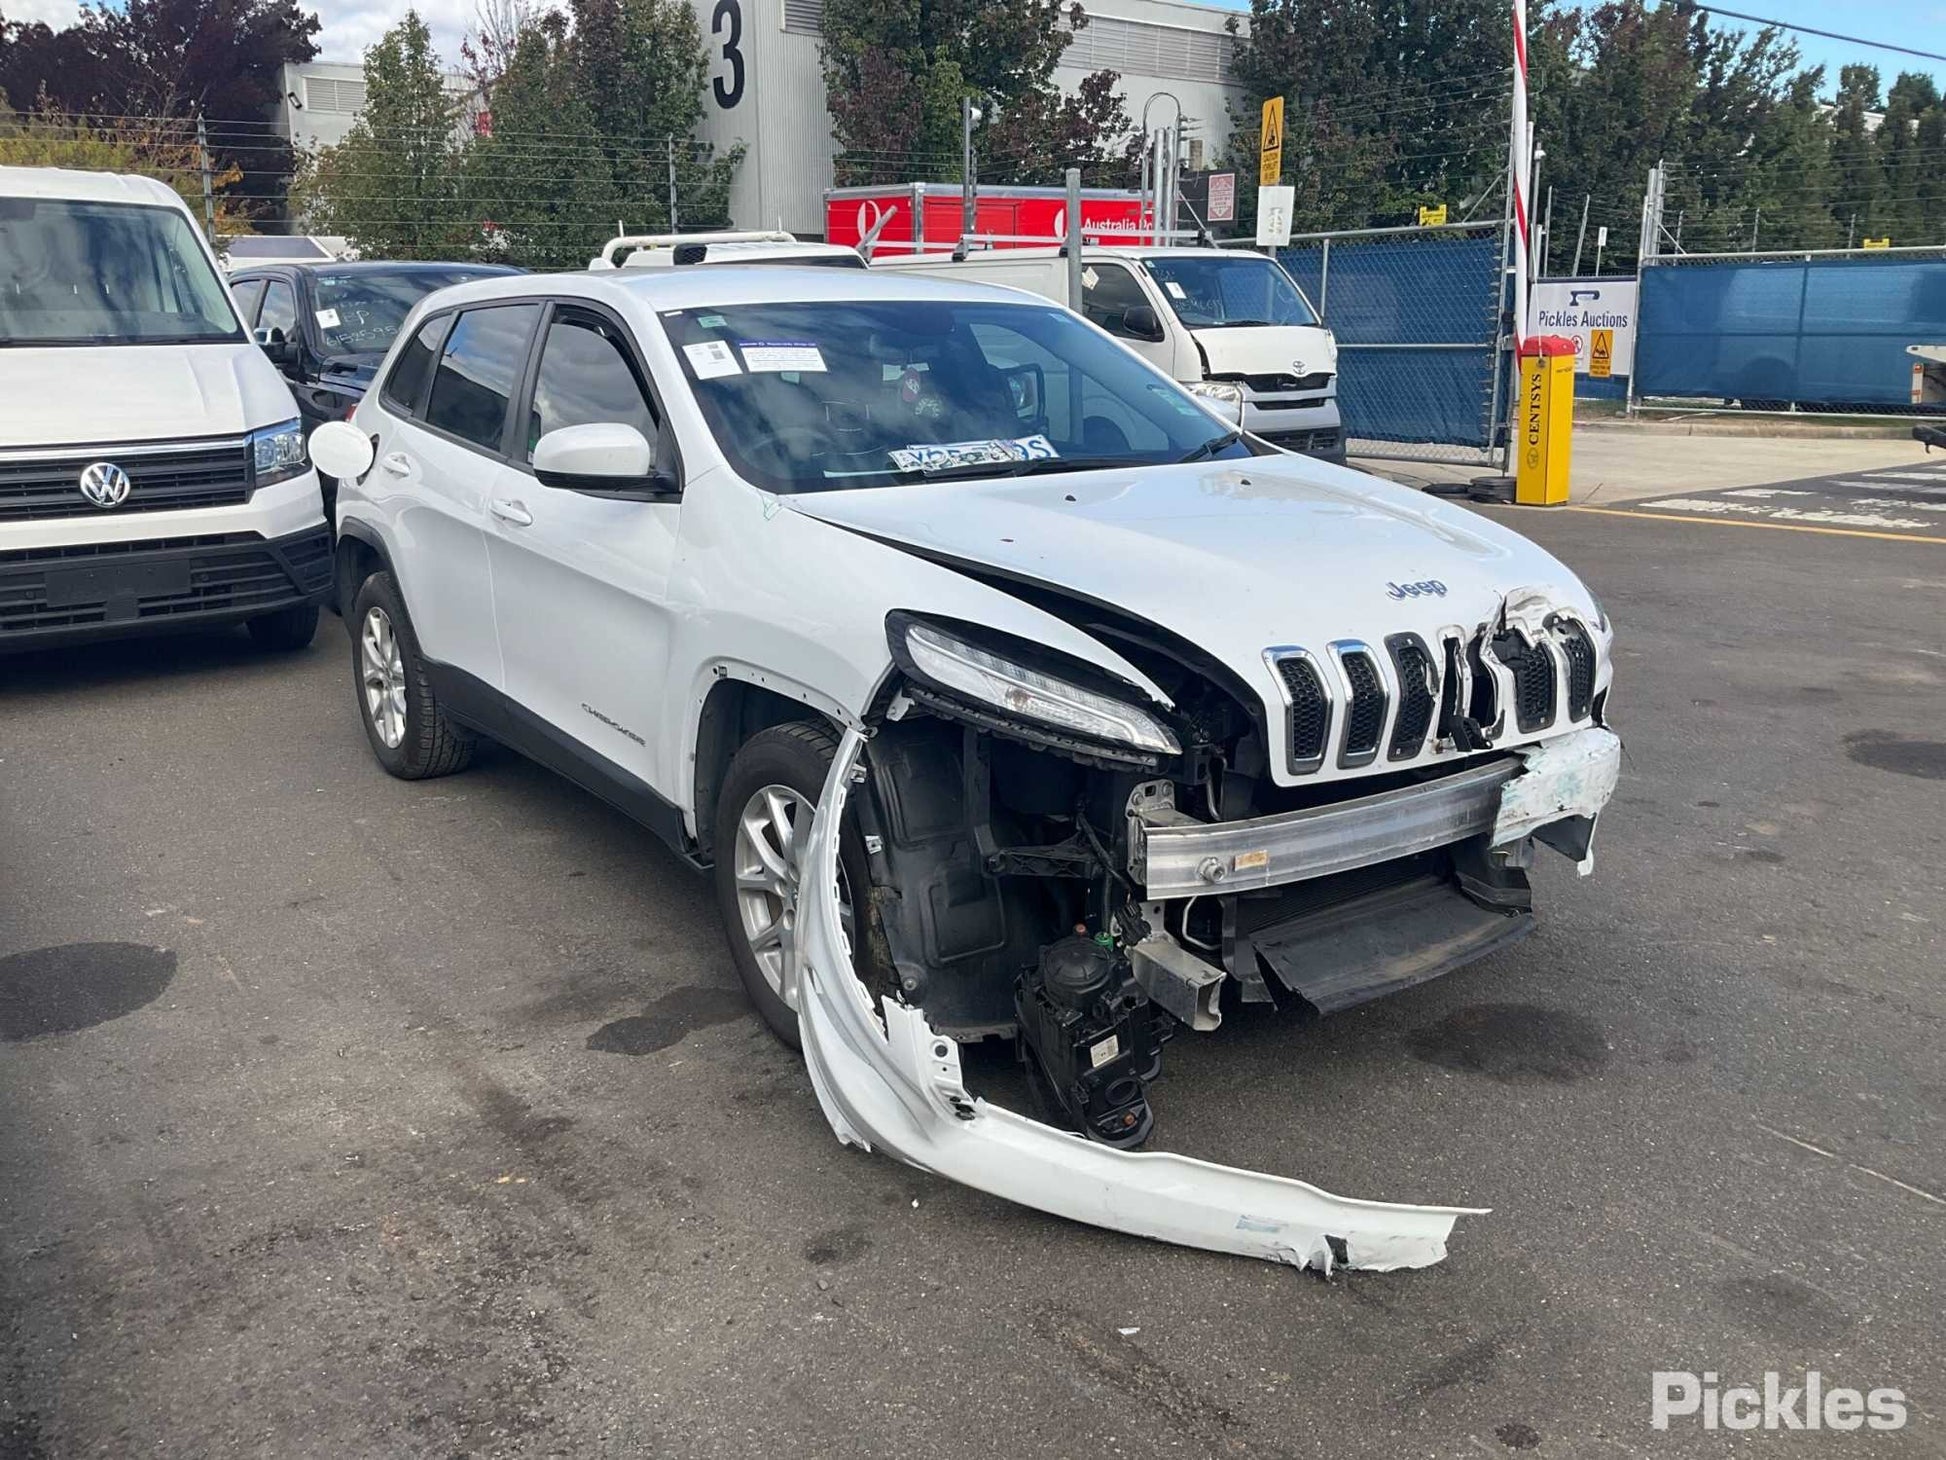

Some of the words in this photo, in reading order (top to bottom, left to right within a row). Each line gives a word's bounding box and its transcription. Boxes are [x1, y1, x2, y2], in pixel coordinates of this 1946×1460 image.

[712, 0, 745, 109] 3
[1083, 218, 1136, 231] Australia
[1538, 311, 1577, 327] Pickles
[1580, 311, 1628, 328] Auctions
[1528, 373, 1542, 445] CENTSYS
[1385, 580, 1448, 601] Jeep
